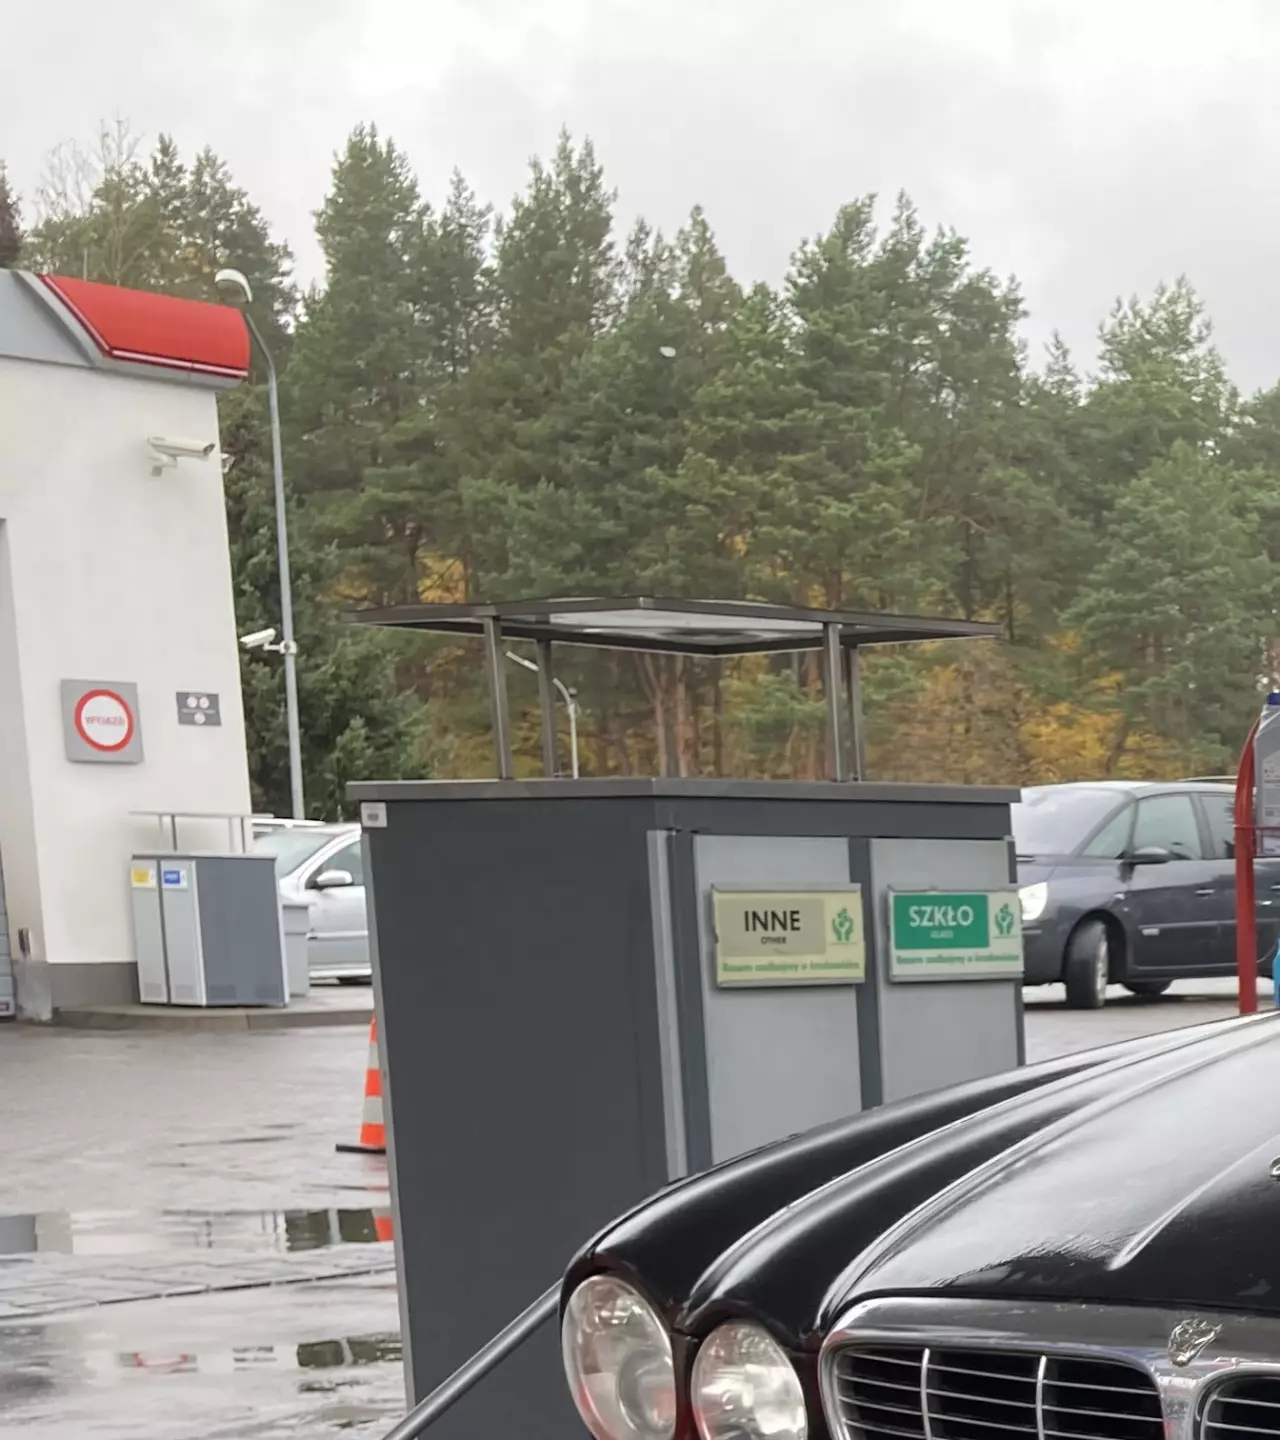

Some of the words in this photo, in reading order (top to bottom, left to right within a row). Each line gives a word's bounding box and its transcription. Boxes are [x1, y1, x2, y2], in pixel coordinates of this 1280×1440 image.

[744, 910, 801, 932] INNE
[908, 905, 975, 928] SZKŁO
[760, 936, 787, 945] OTHER
